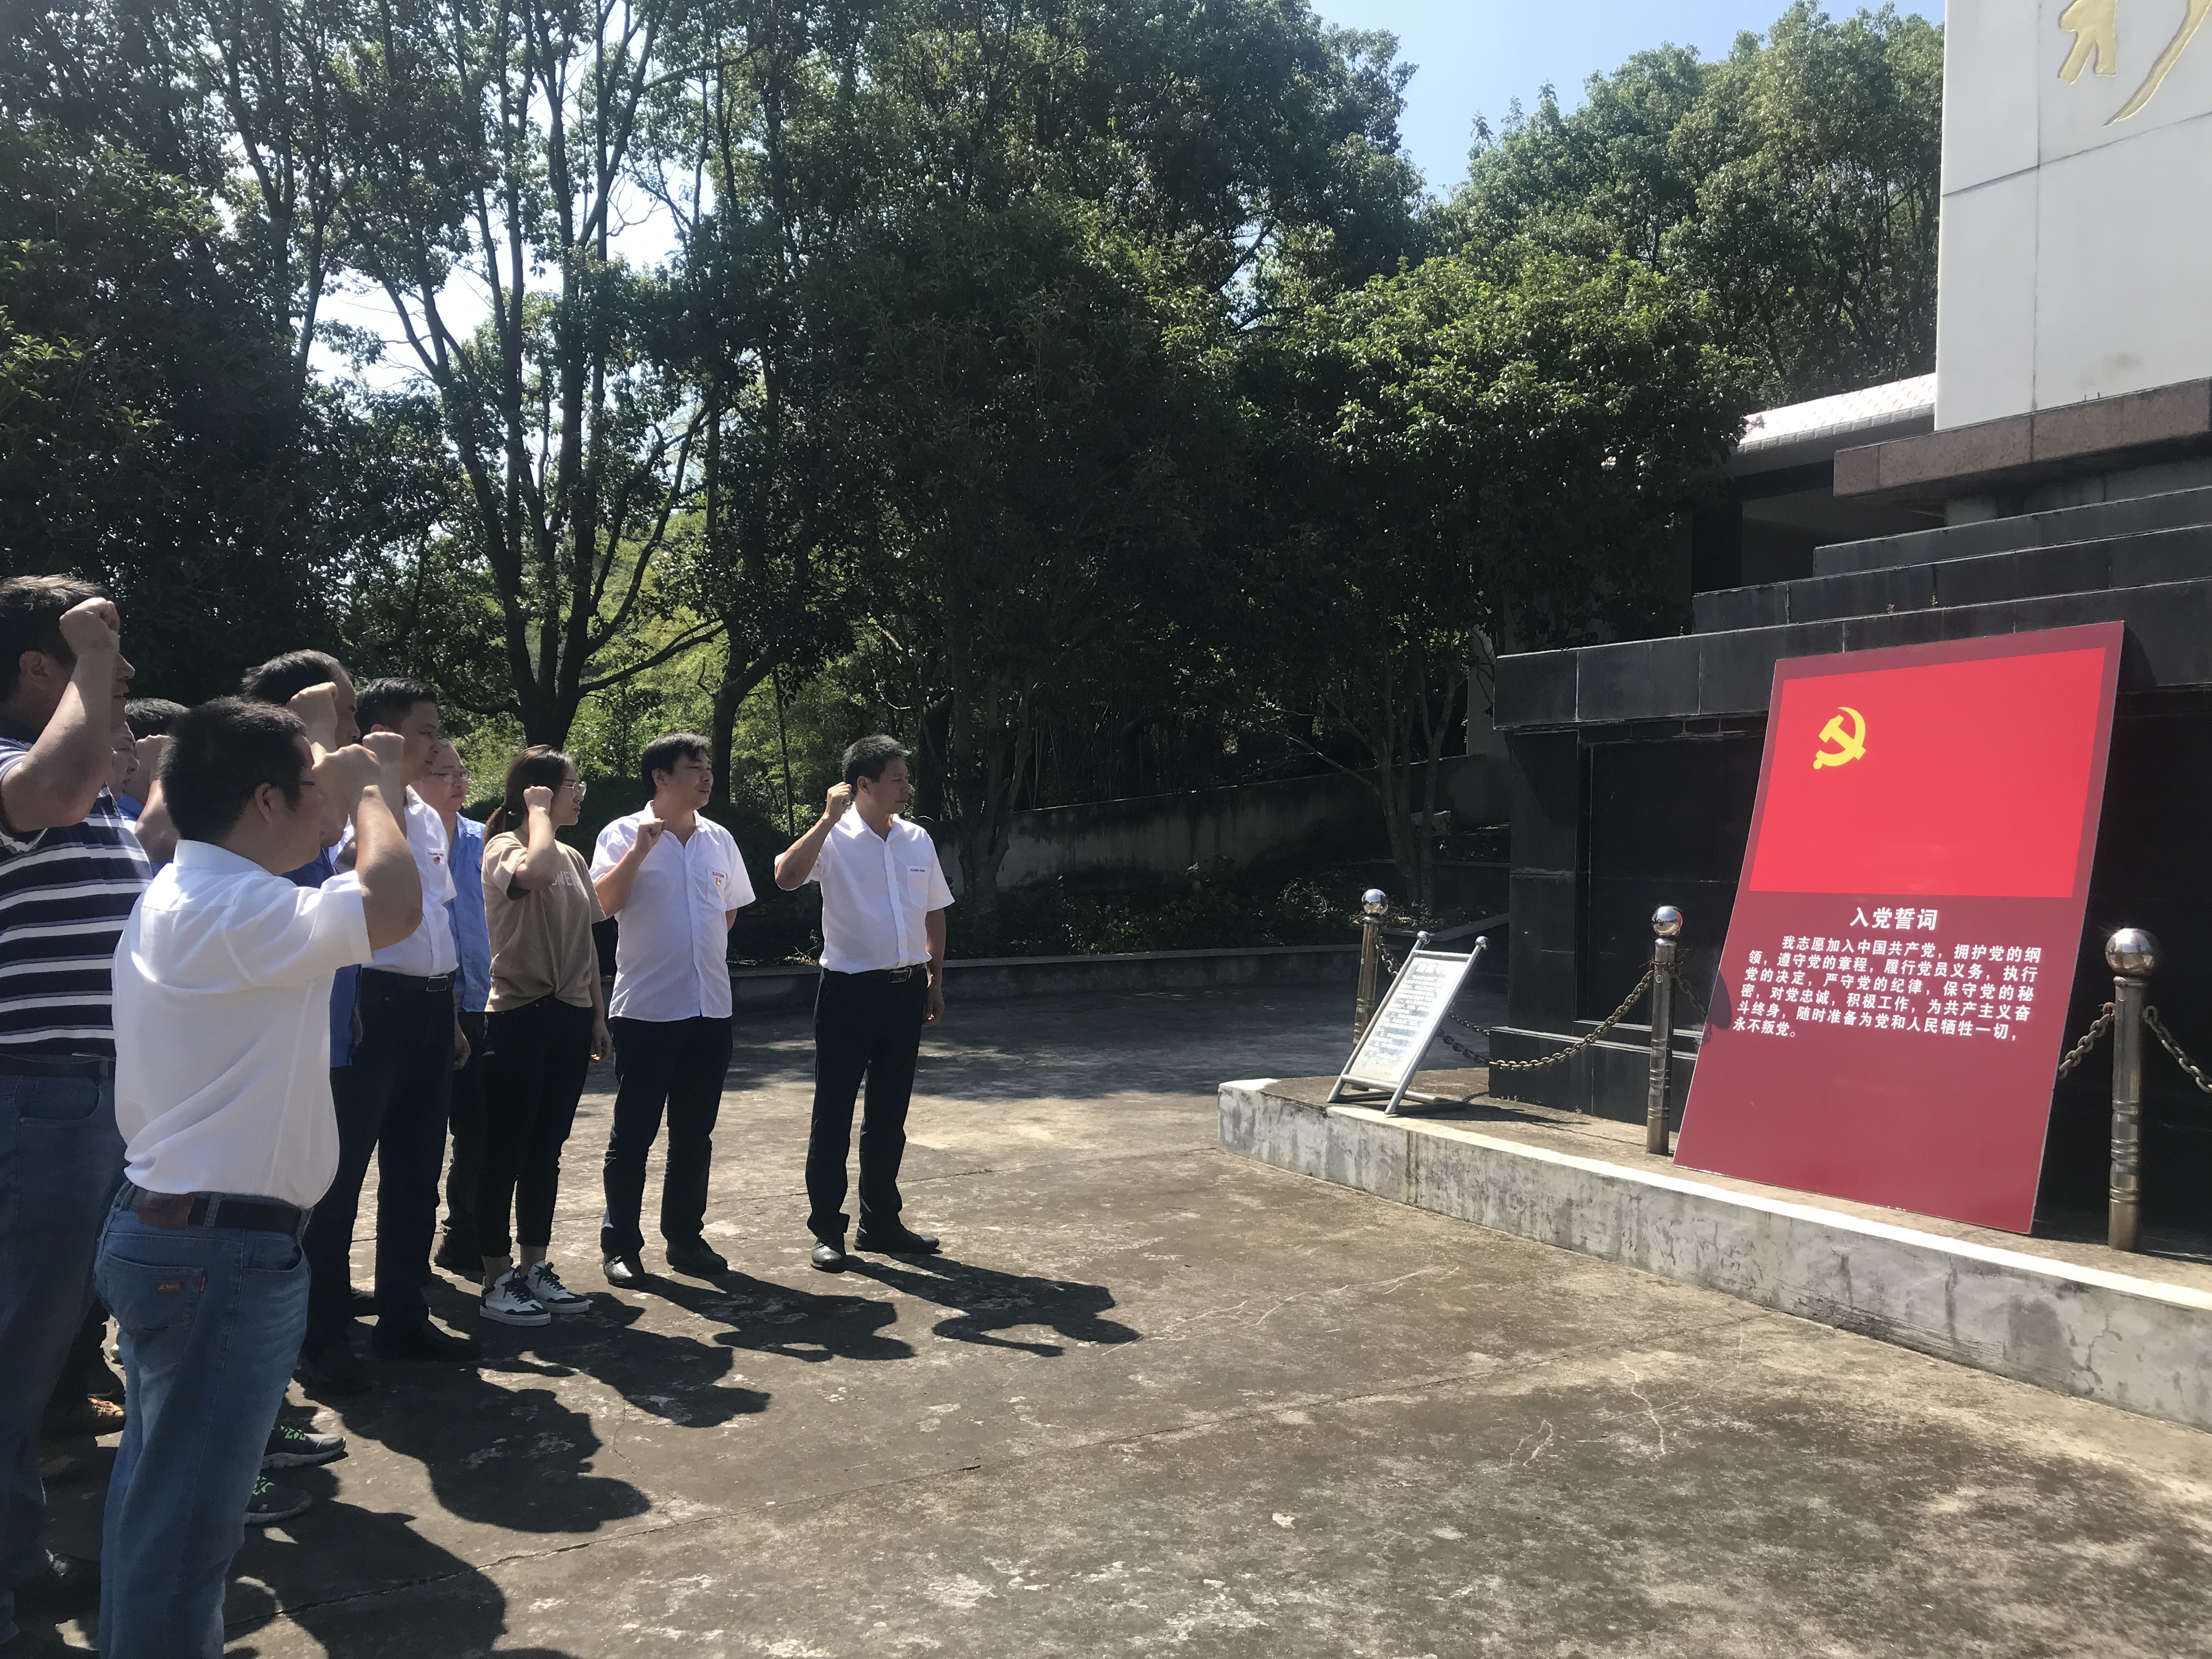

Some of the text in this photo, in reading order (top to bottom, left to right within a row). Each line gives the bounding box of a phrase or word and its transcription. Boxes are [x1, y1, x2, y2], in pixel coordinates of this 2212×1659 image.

[1849, 906, 1938, 931] 入党誓词
[1782, 935, 2041, 963] 我志愿加入中国共产党，拥护党的纲
[1748, 950, 2038, 983] 领，遵守党的章程，履行党员义务，执行
[1744, 966, 2034, 1002] 党的决定，严守党的纪律，保守党的秘
[1741, 983, 2031, 1022] 密，对党忠诚，积极工作，为共产主义奋
[1733, 1016, 1796, 1037] 永不叛党。
[1737, 1000, 2017, 1041] 斗终身，随时准备为党和人民牺牲一切，
